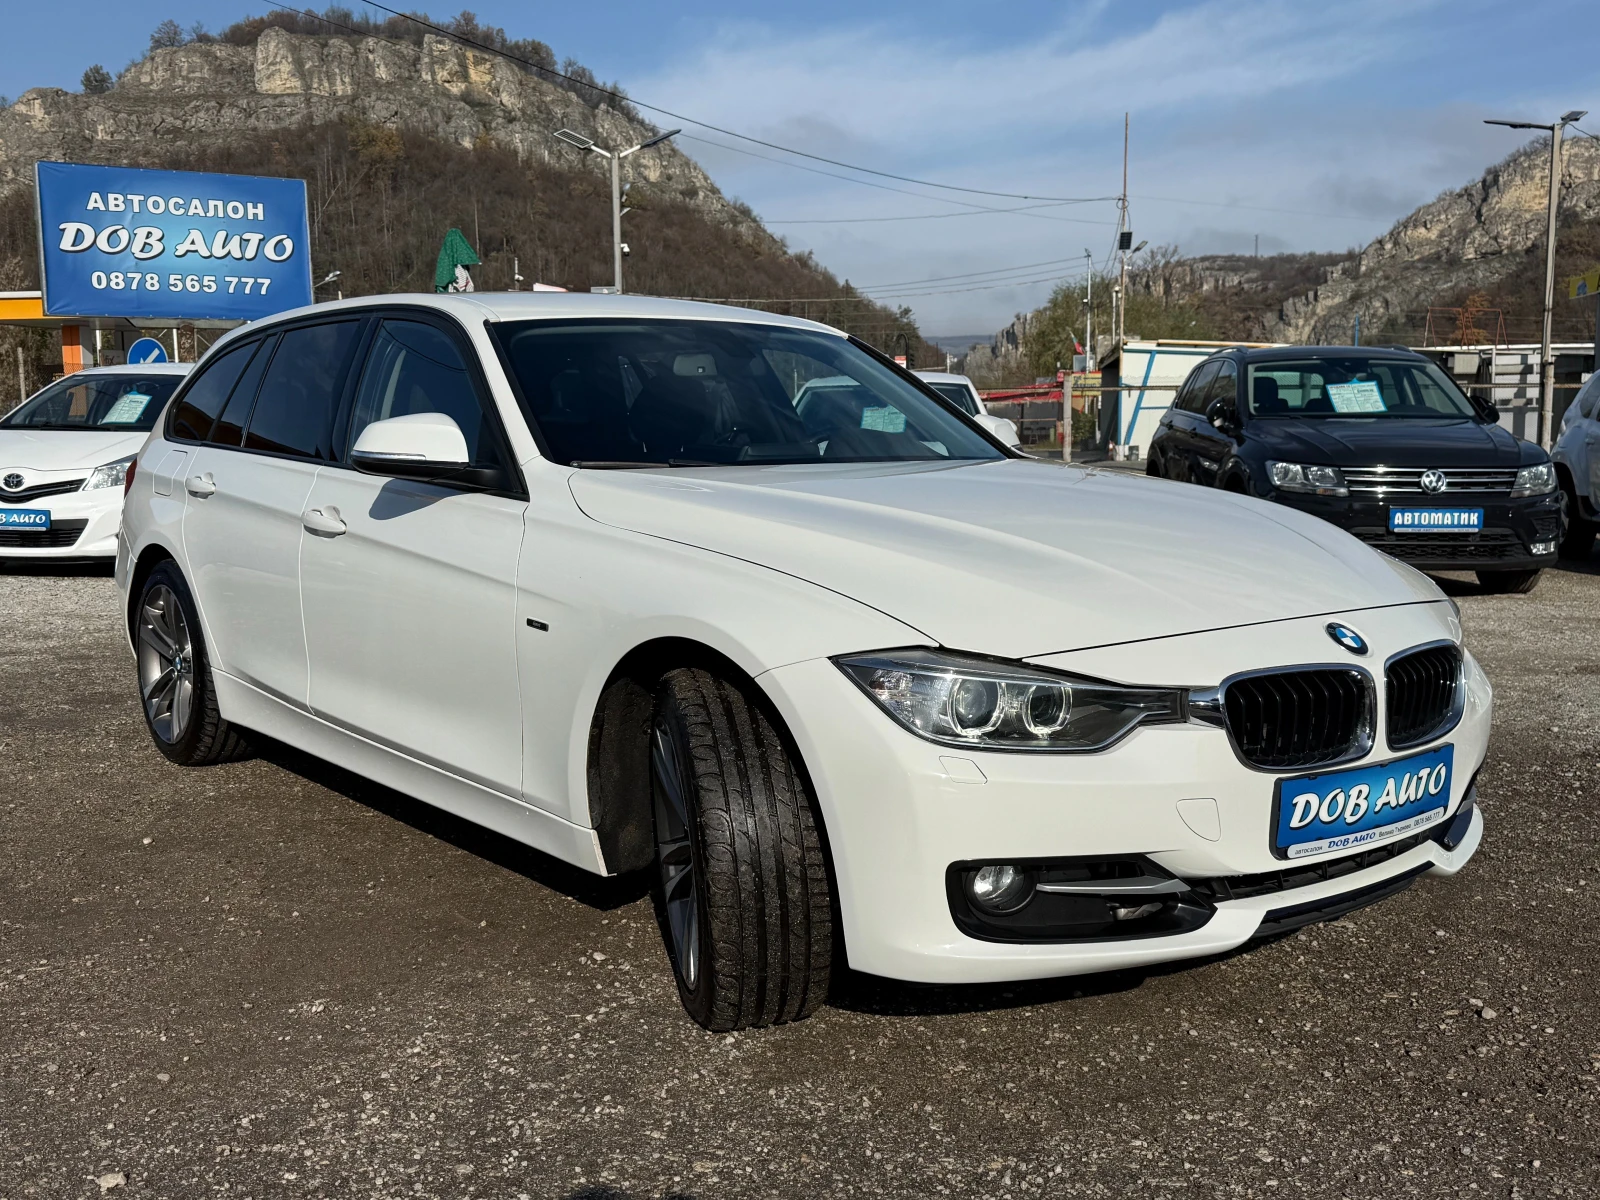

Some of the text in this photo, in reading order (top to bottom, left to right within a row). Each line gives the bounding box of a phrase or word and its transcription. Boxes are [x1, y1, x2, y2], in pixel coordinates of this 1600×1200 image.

[86, 191, 265, 221] АВТОСАЛОН
[58, 221, 295, 262] DOB AUTO
[91, 271, 272, 295] 0878 565 777
[9, 513, 46, 523] AUTO
[1394, 512, 1479, 525] АВТОМАТИК
[1289, 762, 1447, 829] DOB AUTO
[1327, 838, 1350, 849] DOB
[1351, 831, 1376, 845] AUTO
